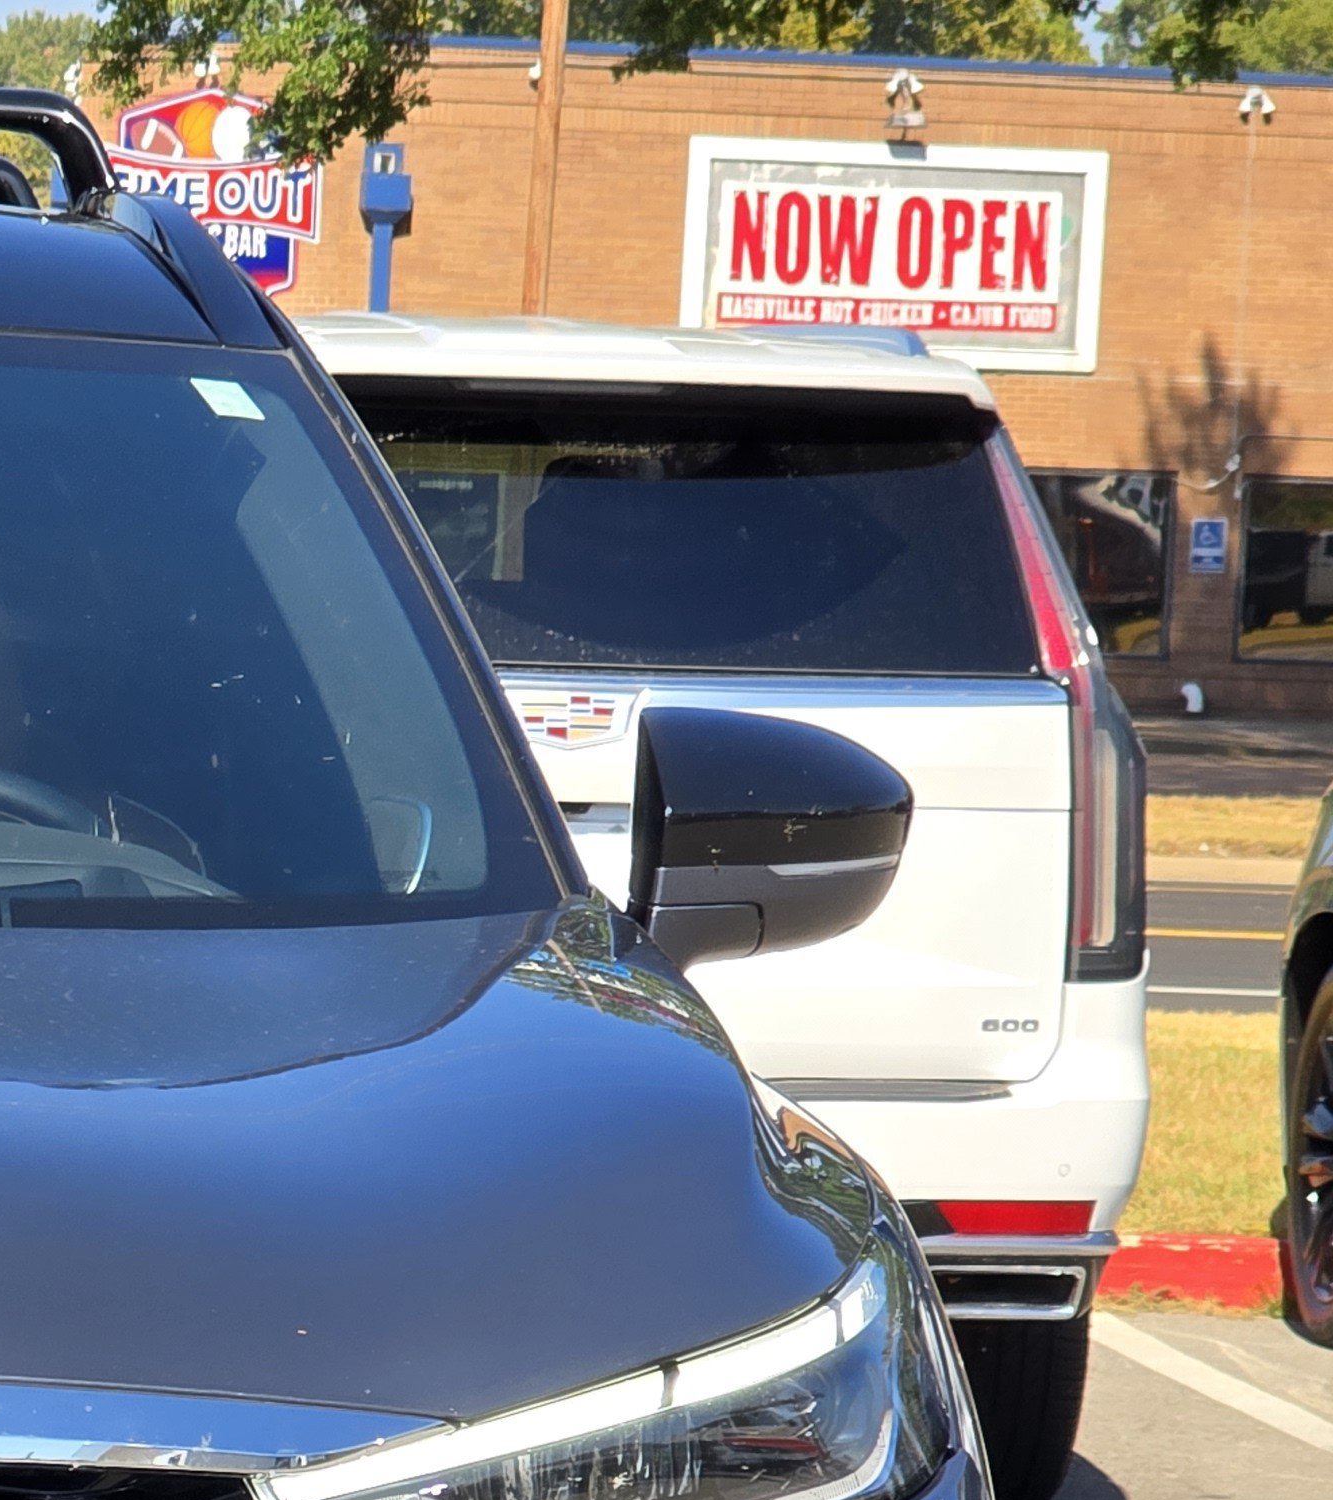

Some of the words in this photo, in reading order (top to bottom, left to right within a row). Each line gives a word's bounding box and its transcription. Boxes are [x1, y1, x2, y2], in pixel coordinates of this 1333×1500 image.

[214, 166, 312, 223] OUT
[223, 223, 267, 260] BAR
[730, 190, 880, 285] NOW
[897, 196, 1052, 292] OPEN
[720, 294, 816, 321] NASHVILLE
[820, 298, 856, 325] HOT
[858, 301, 935, 326] CHICKEN
[949, 304, 1005, 328] CAJUN
[1008, 305, 1054, 330] FOOD
[981, 1019, 1040, 1033] 600
